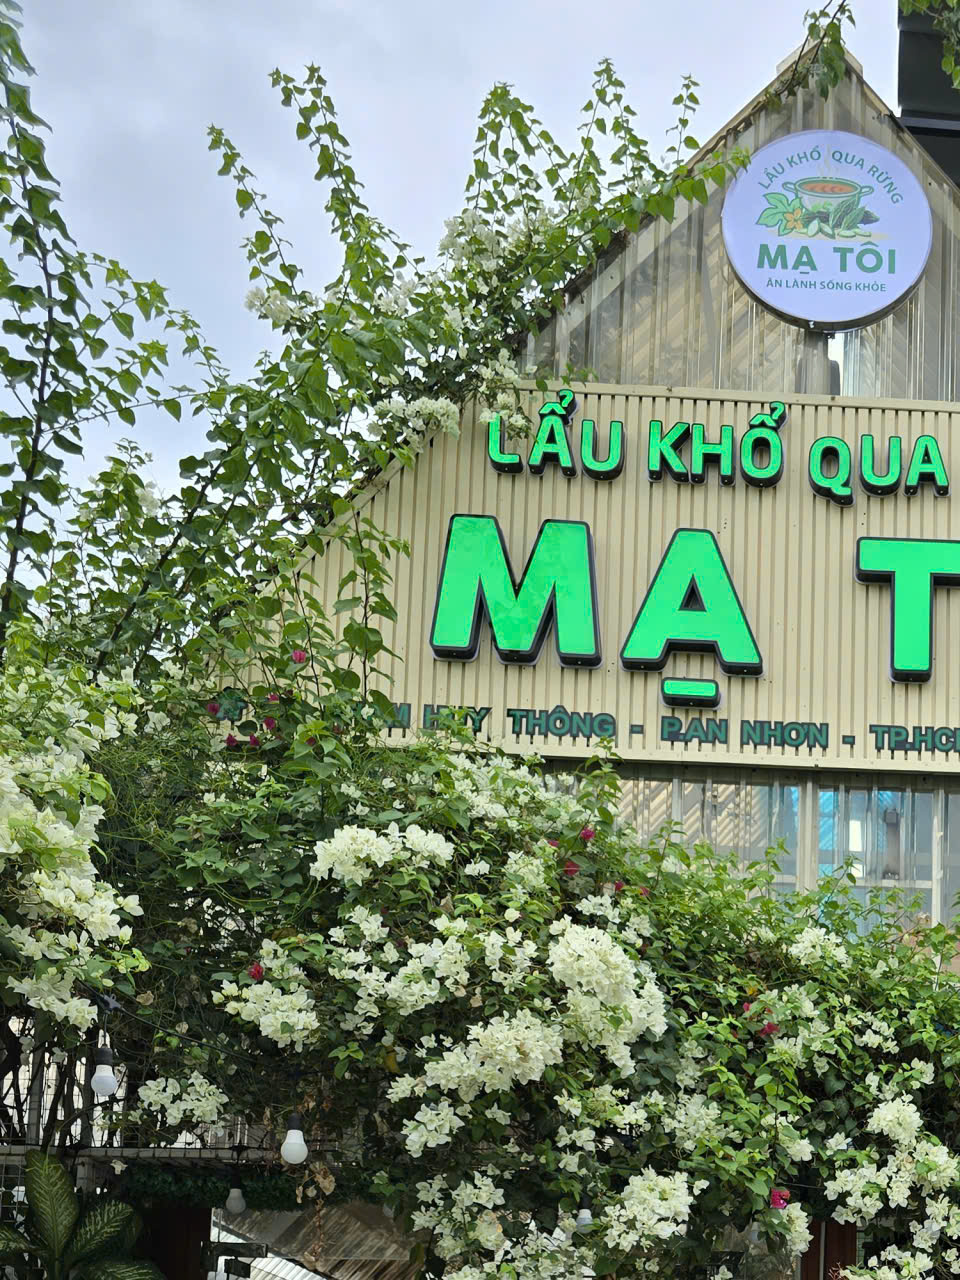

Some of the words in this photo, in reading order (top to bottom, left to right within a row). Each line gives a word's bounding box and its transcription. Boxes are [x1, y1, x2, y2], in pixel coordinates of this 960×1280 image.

[758, 162, 785, 190] LẨU
[832, 150, 865, 169] QUA
[867, 165, 904, 204] RỪNG
[757, 243, 818, 274] MẠ
[833, 241, 896, 274] TÔI
[785, 278, 817, 289] LÀNH
[487, 389, 626, 480] LẨU
[647, 401, 787, 487] KHỔ
[808, 433, 950, 505] QUA
[430, 514, 764, 708] MẠ
[423, 704, 492, 732] HY
[507, 705, 617, 738] THÔNG
